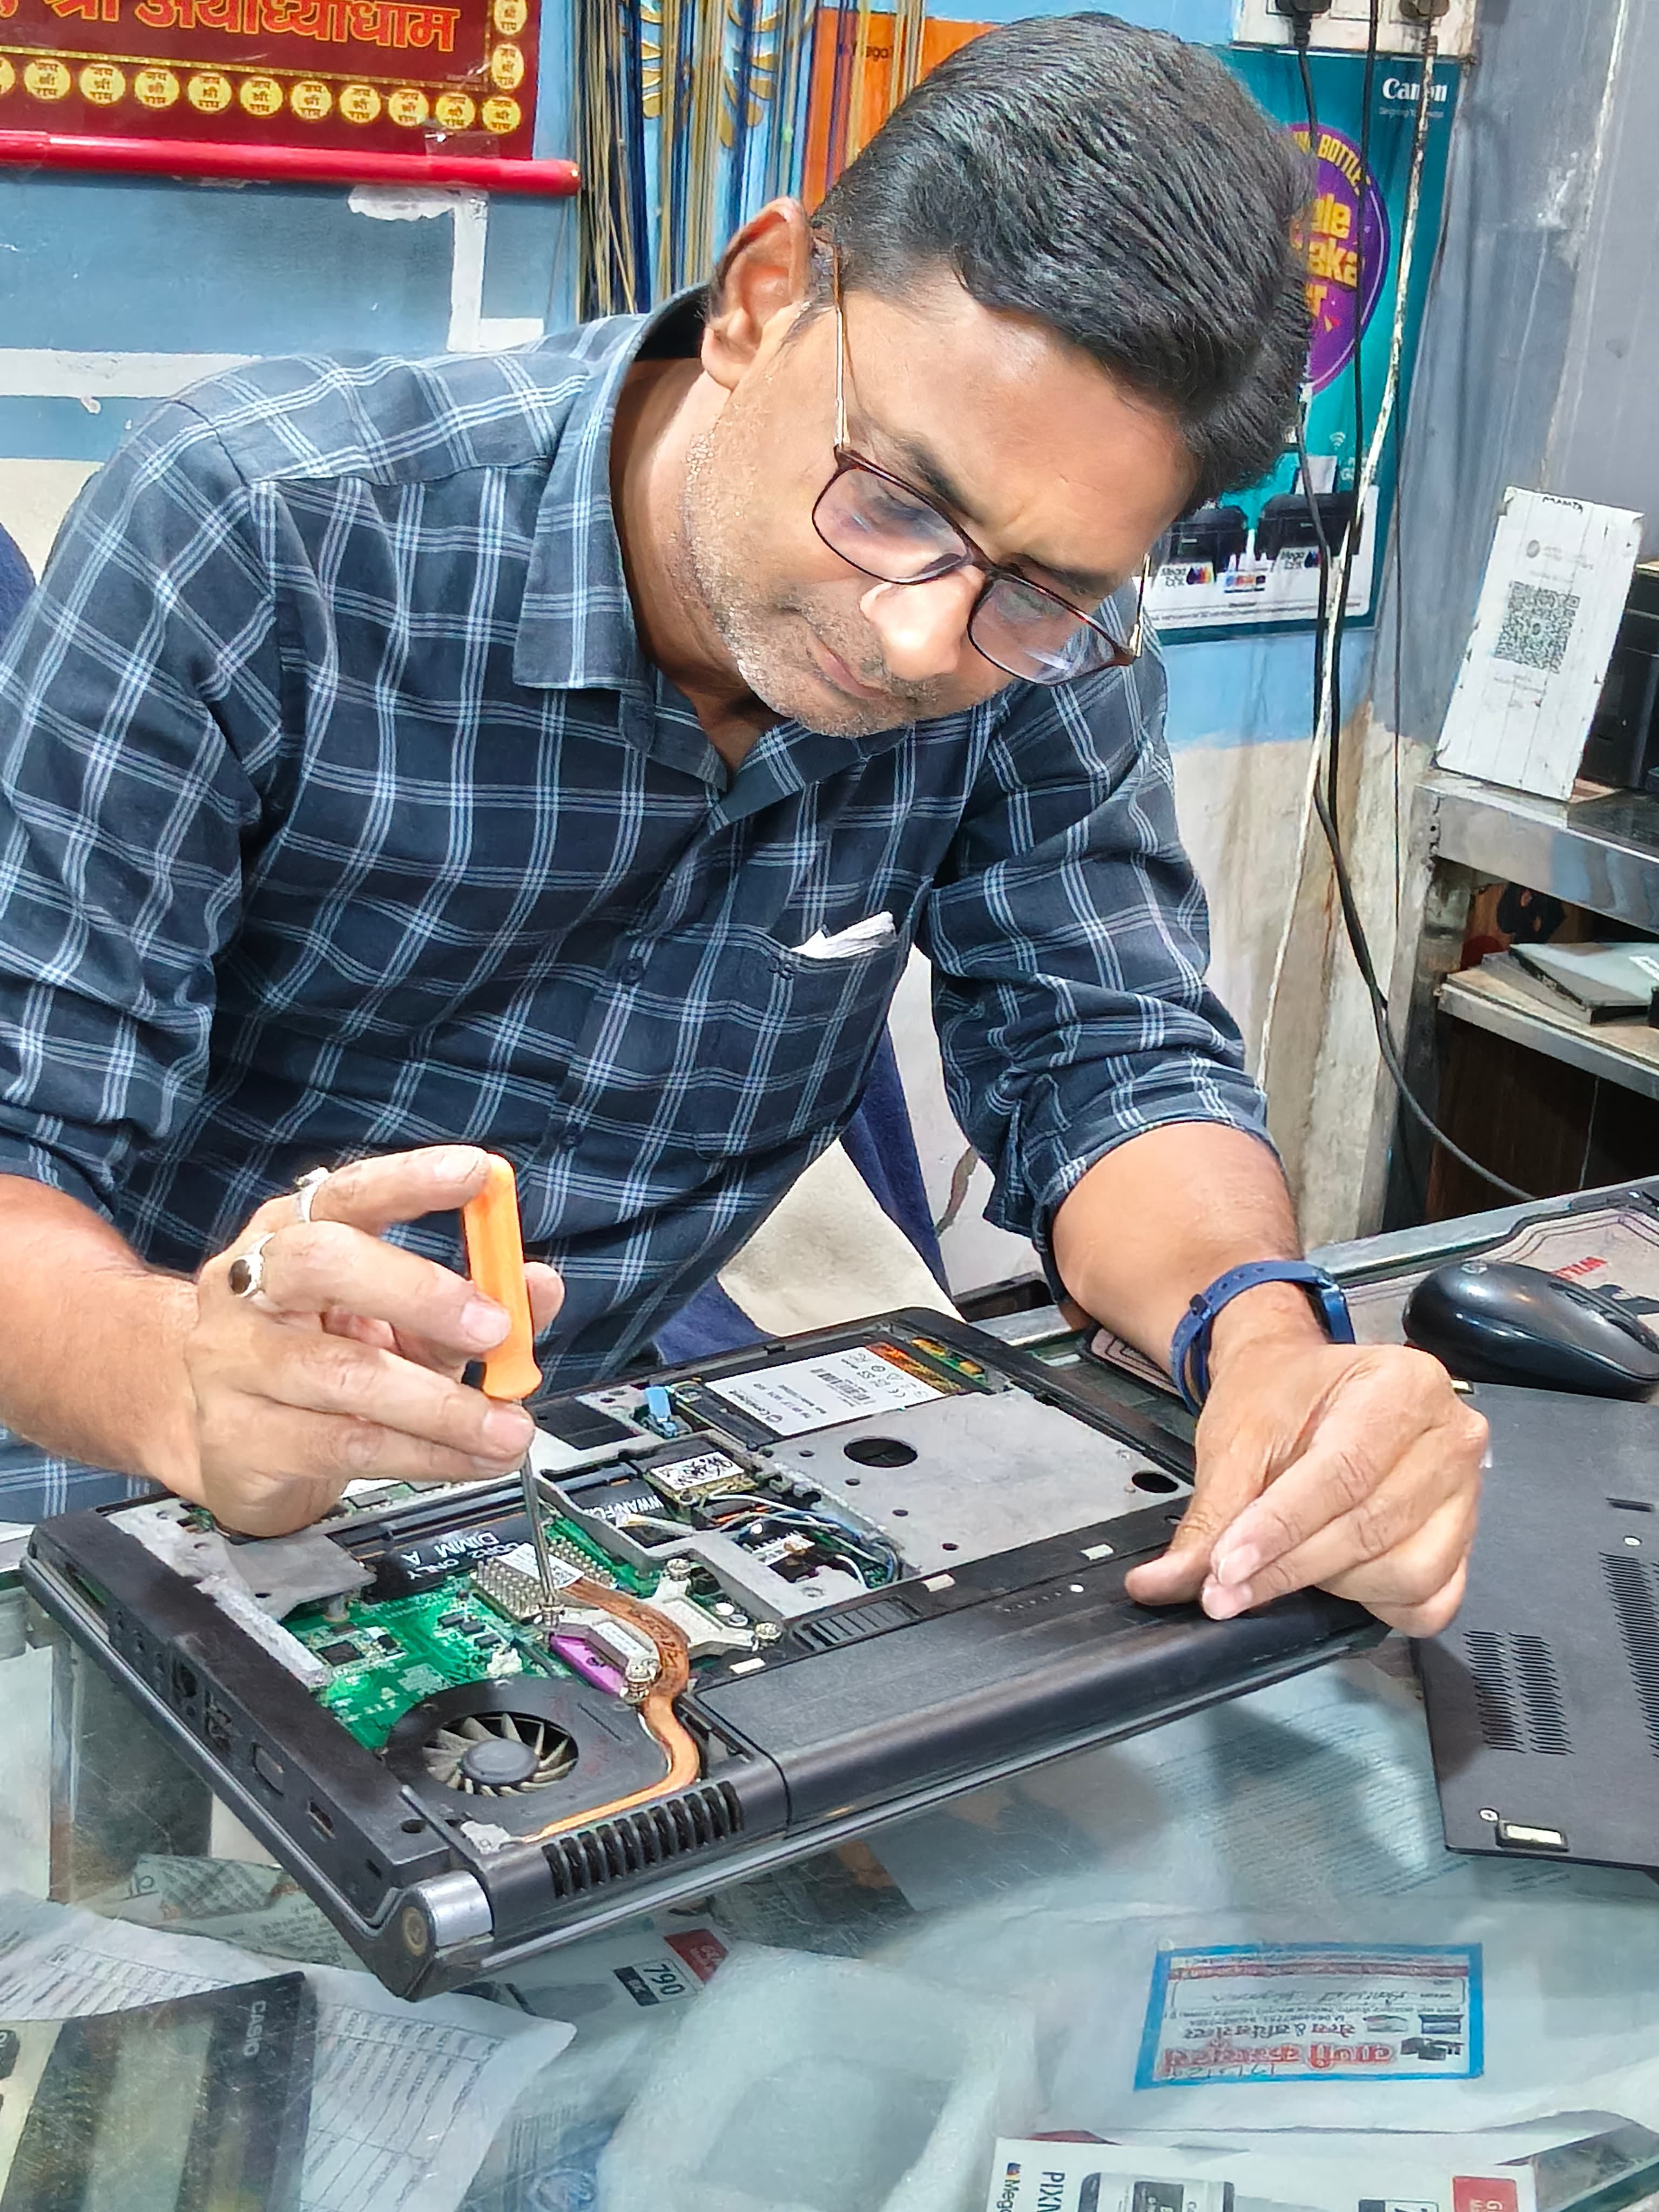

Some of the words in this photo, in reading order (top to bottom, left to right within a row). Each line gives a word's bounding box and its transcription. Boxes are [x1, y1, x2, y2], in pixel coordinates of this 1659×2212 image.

[401, 1550, 421, 1566] A
[434, 1532, 500, 1558] DIMM
[407, 1558, 460, 1580] ONLY
[643, 1963, 686, 1995] 790
[242, 2000, 267, 2057] CASIO
